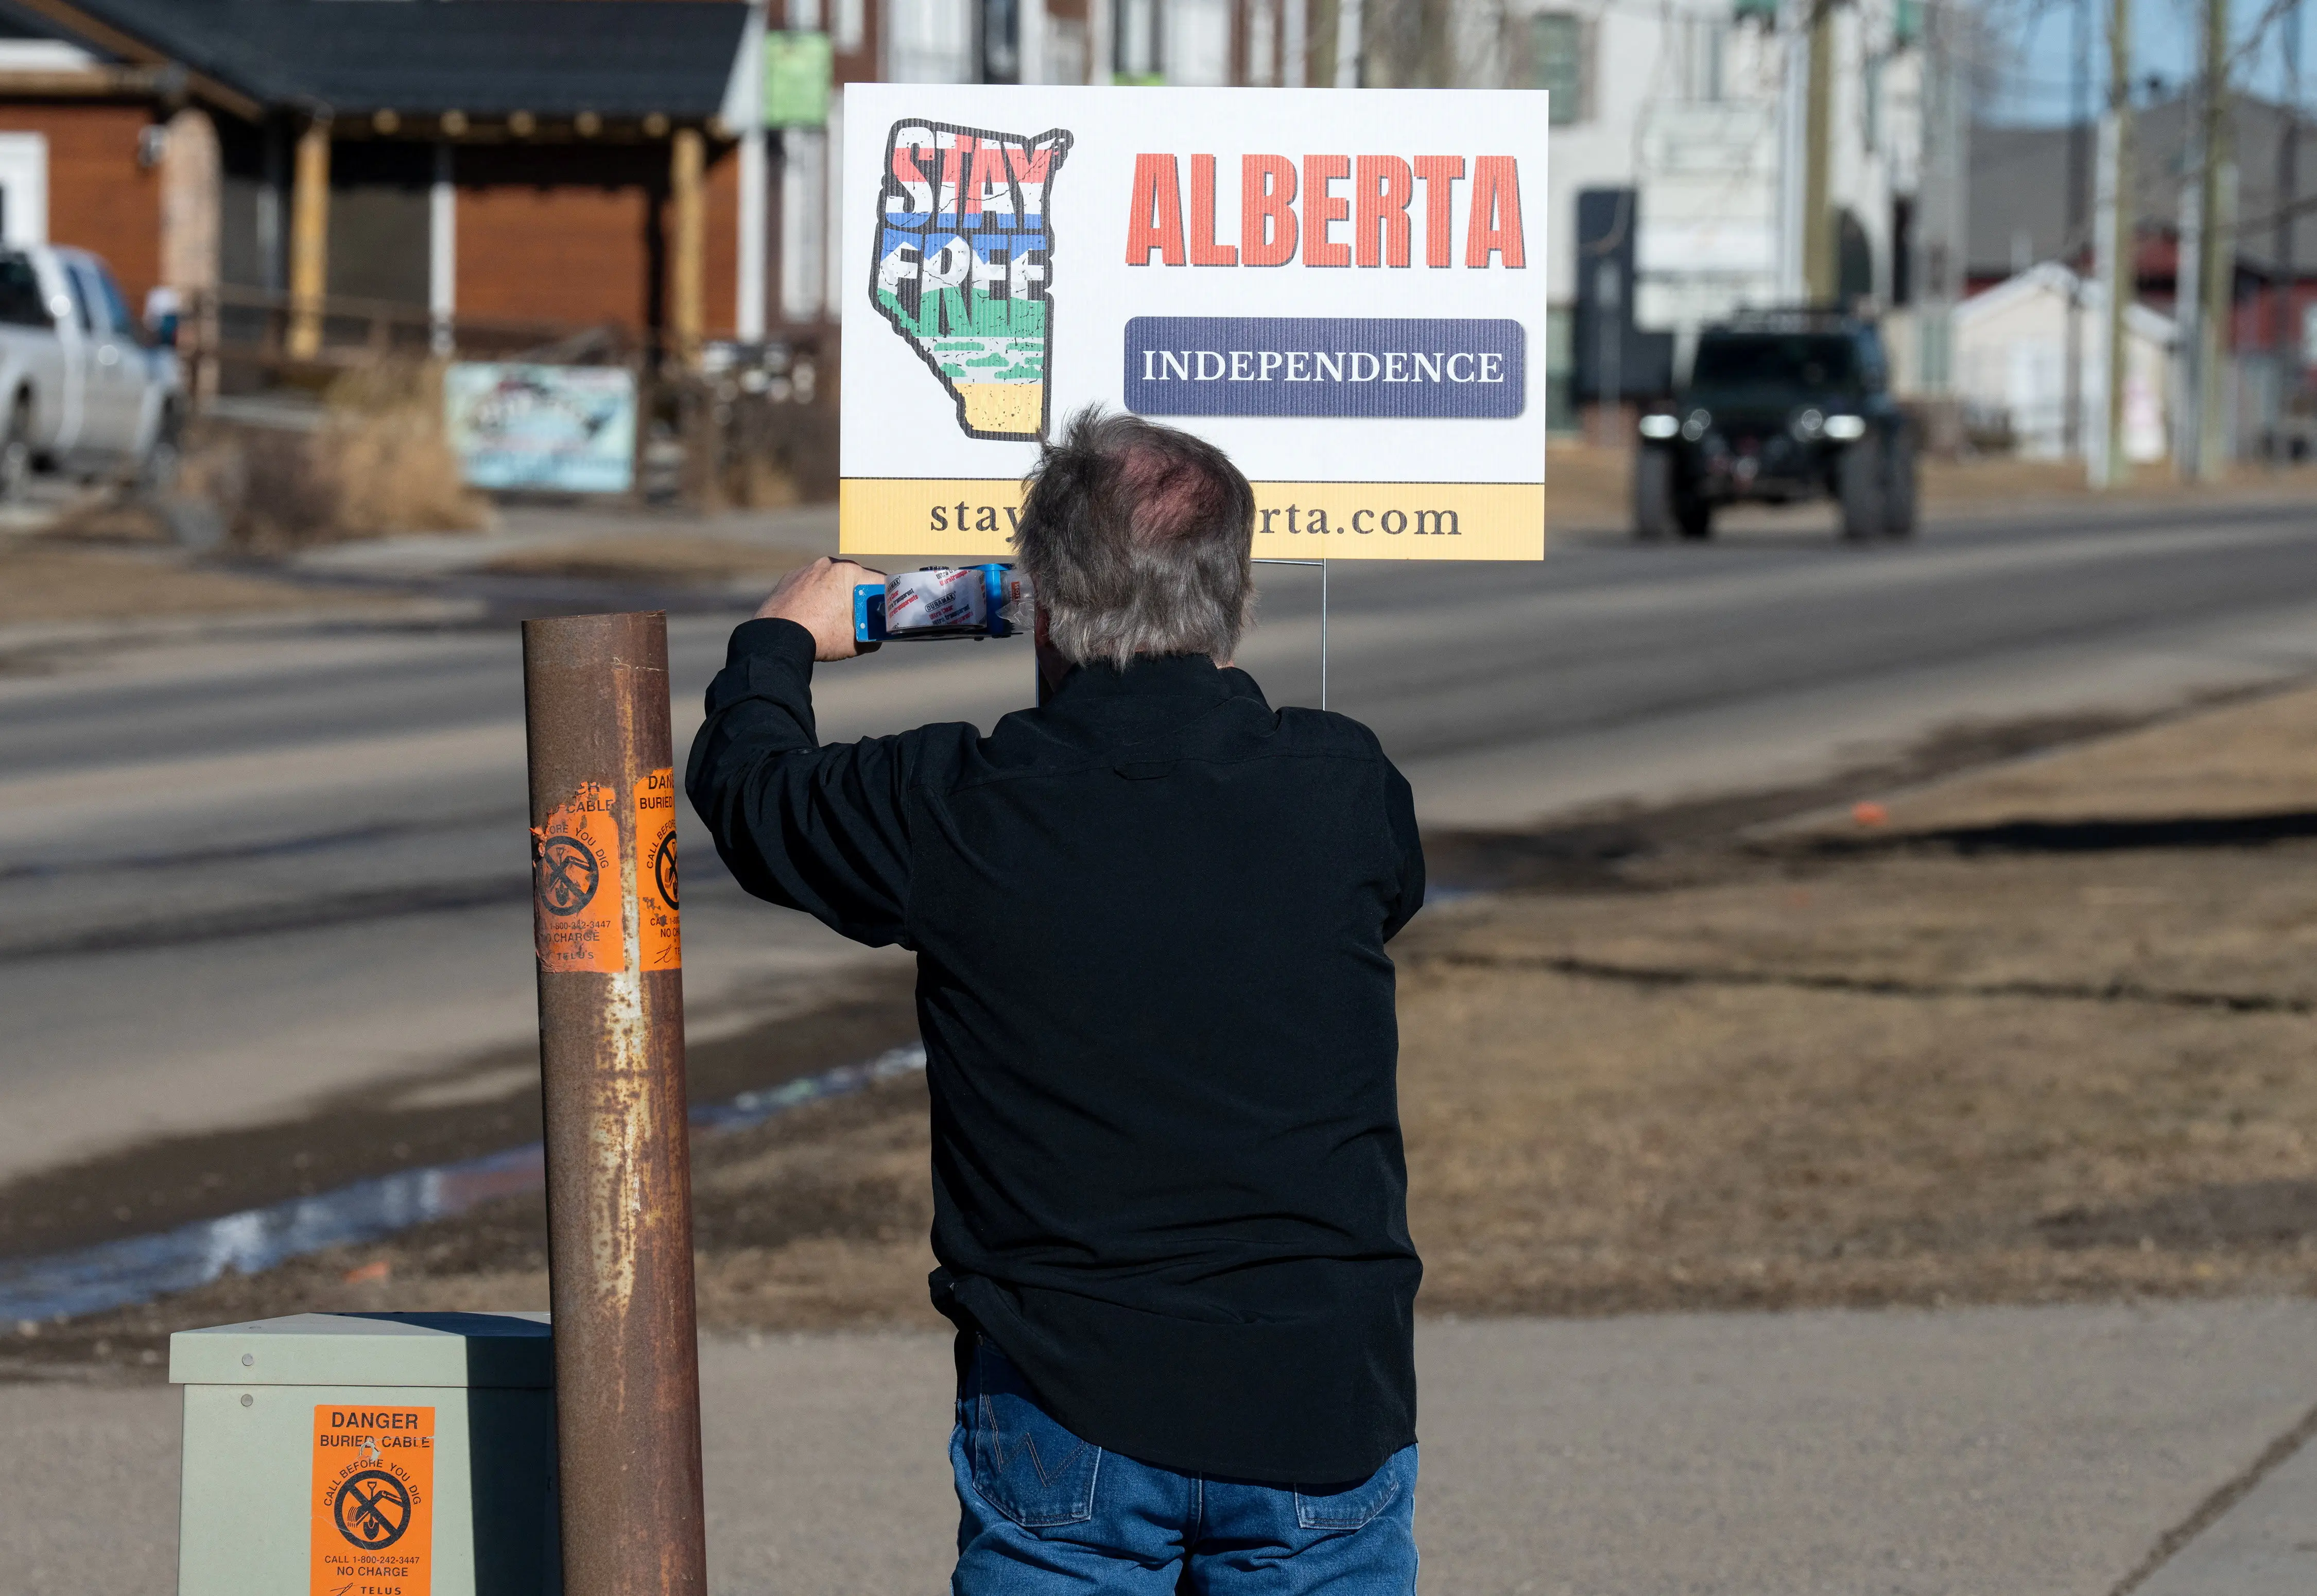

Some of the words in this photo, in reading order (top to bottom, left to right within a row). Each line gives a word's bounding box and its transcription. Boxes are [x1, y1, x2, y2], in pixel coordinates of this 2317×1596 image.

[886, 126, 1058, 229] STAY
[1125, 153, 1527, 269] ALBERTA
[877, 228, 1046, 337] FREE
[1142, 351, 1504, 384] INDEPENDENCE
[926, 594, 955, 611] DURAMAX
[639, 796, 672, 809] BURIED
[575, 827, 596, 846] YOU
[595, 848, 609, 869] DIG
[646, 842, 659, 869] CALL
[554, 932, 600, 942] CHARGE
[660, 928, 671, 938] NO
[557, 951, 594, 960] TELUS
[332, 1412, 418, 1430] DANGER
[382, 1436, 430, 1448] CABLE
[324, 1480, 341, 1506] CALL
[339, 1459, 384, 1479] BEFORE
[391, 1463, 410, 1482] YOU
[409, 1485, 421, 1505] DIG
[324, 1555, 349, 1564] CALL
[353, 1556, 420, 1564] 1-800-242-3447
[337, 1567, 354, 1576] NO
[358, 1567, 408, 1577] CHARGE
[360, 1586, 402, 1595] TELUS
